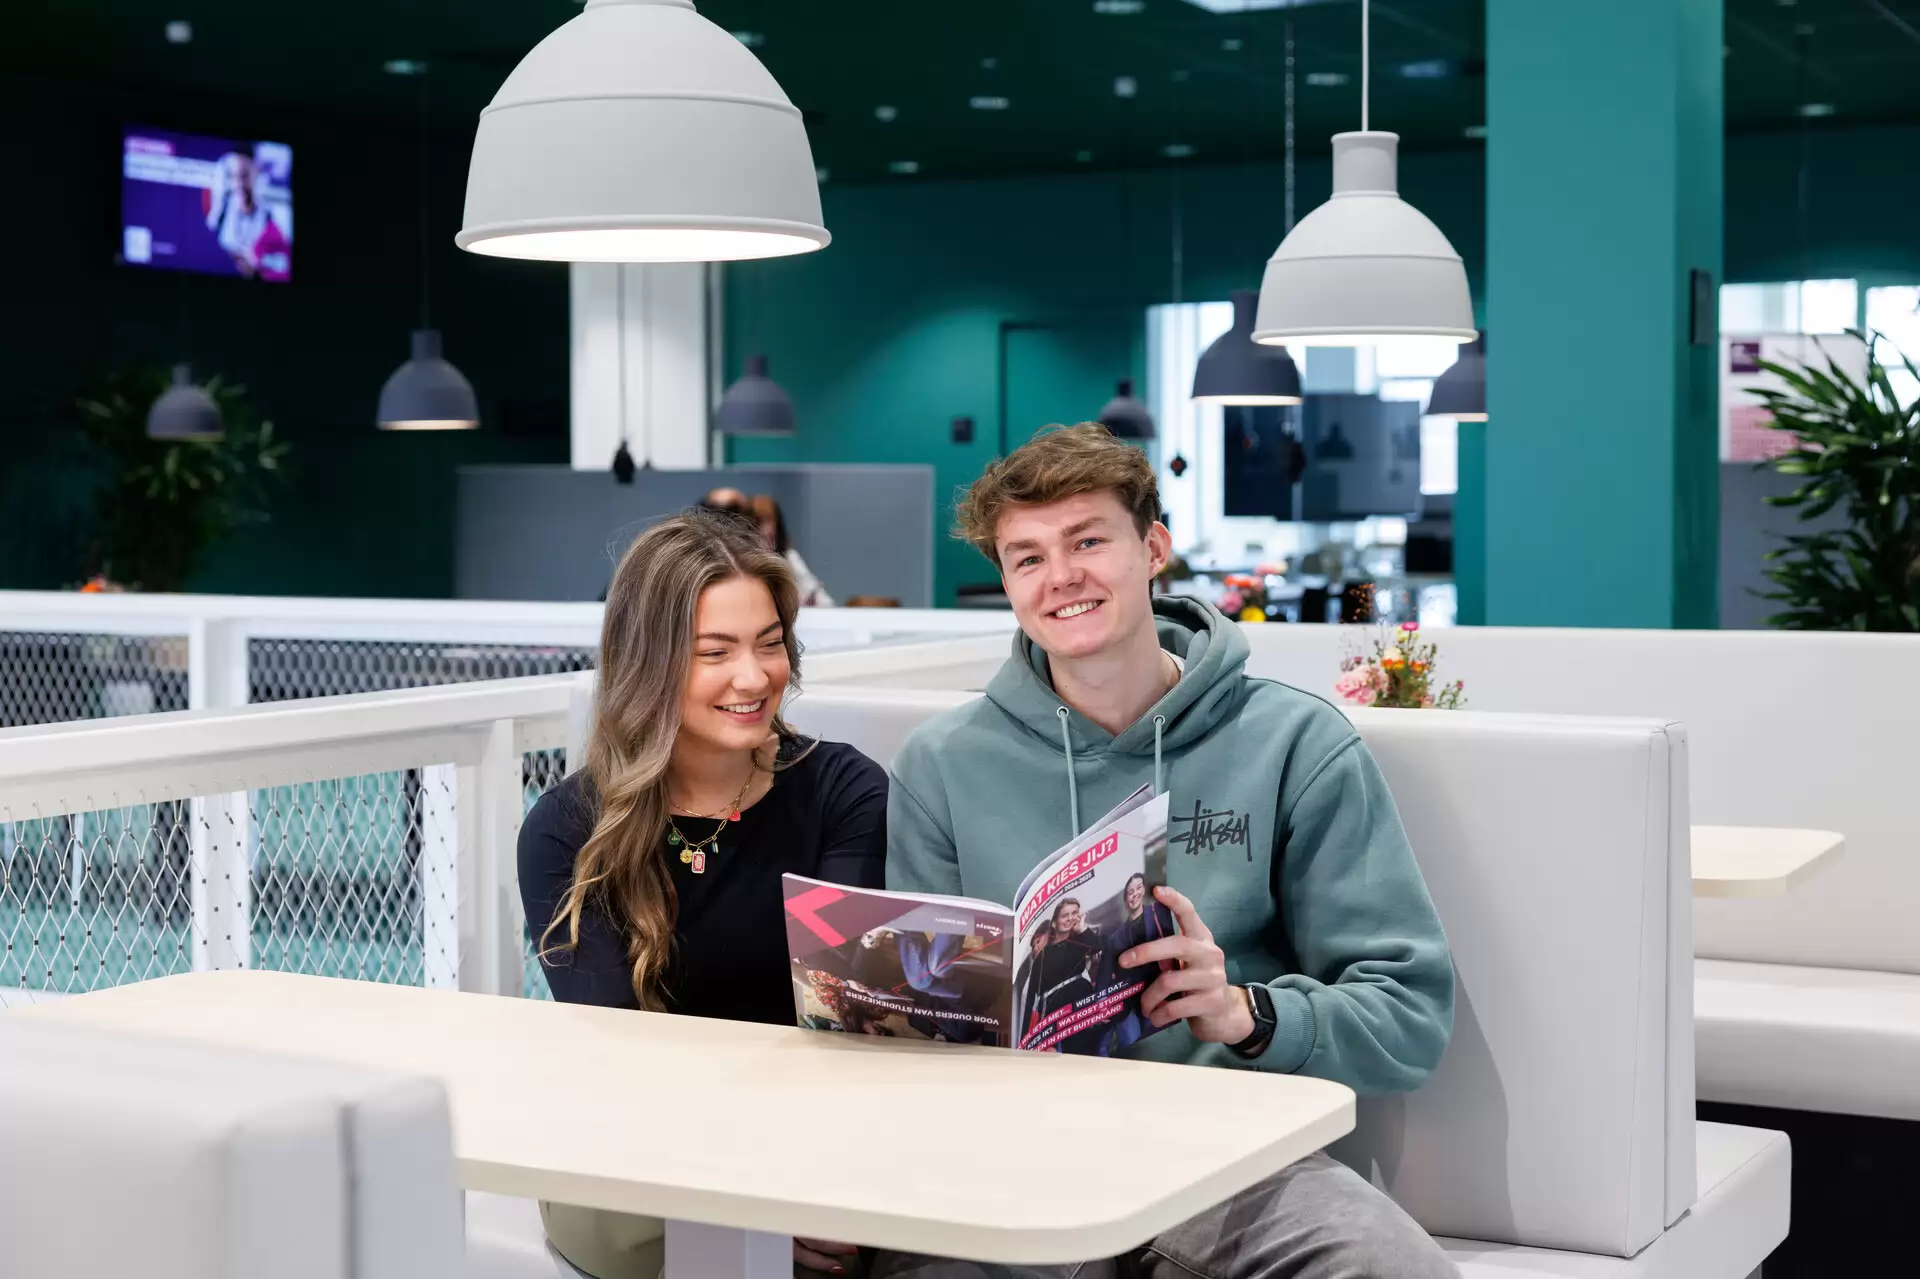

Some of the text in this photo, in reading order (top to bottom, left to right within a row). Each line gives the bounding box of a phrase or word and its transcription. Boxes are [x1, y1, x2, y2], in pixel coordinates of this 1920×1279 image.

[1021, 889, 1046, 926] WAT
[1047, 861, 1079, 895] KIES
[1082, 838, 1114, 868] JIJ?
[845, 991, 1000, 1025] VOOR OUDERS VAN STUDIEKIEZERS
[1059, 984, 1143, 1027] WAT KOST STUDEREN?
[1075, 981, 1129, 1008] WIST JE DAT...
[1027, 1026, 1053, 1049] KIES IK?
[1032, 1020, 1047, 1034] IETS
[1047, 1036, 1056, 1045] IN
[1057, 1028, 1072, 1039] HET
[1073, 1004, 1121, 1031] BUITENLAND
